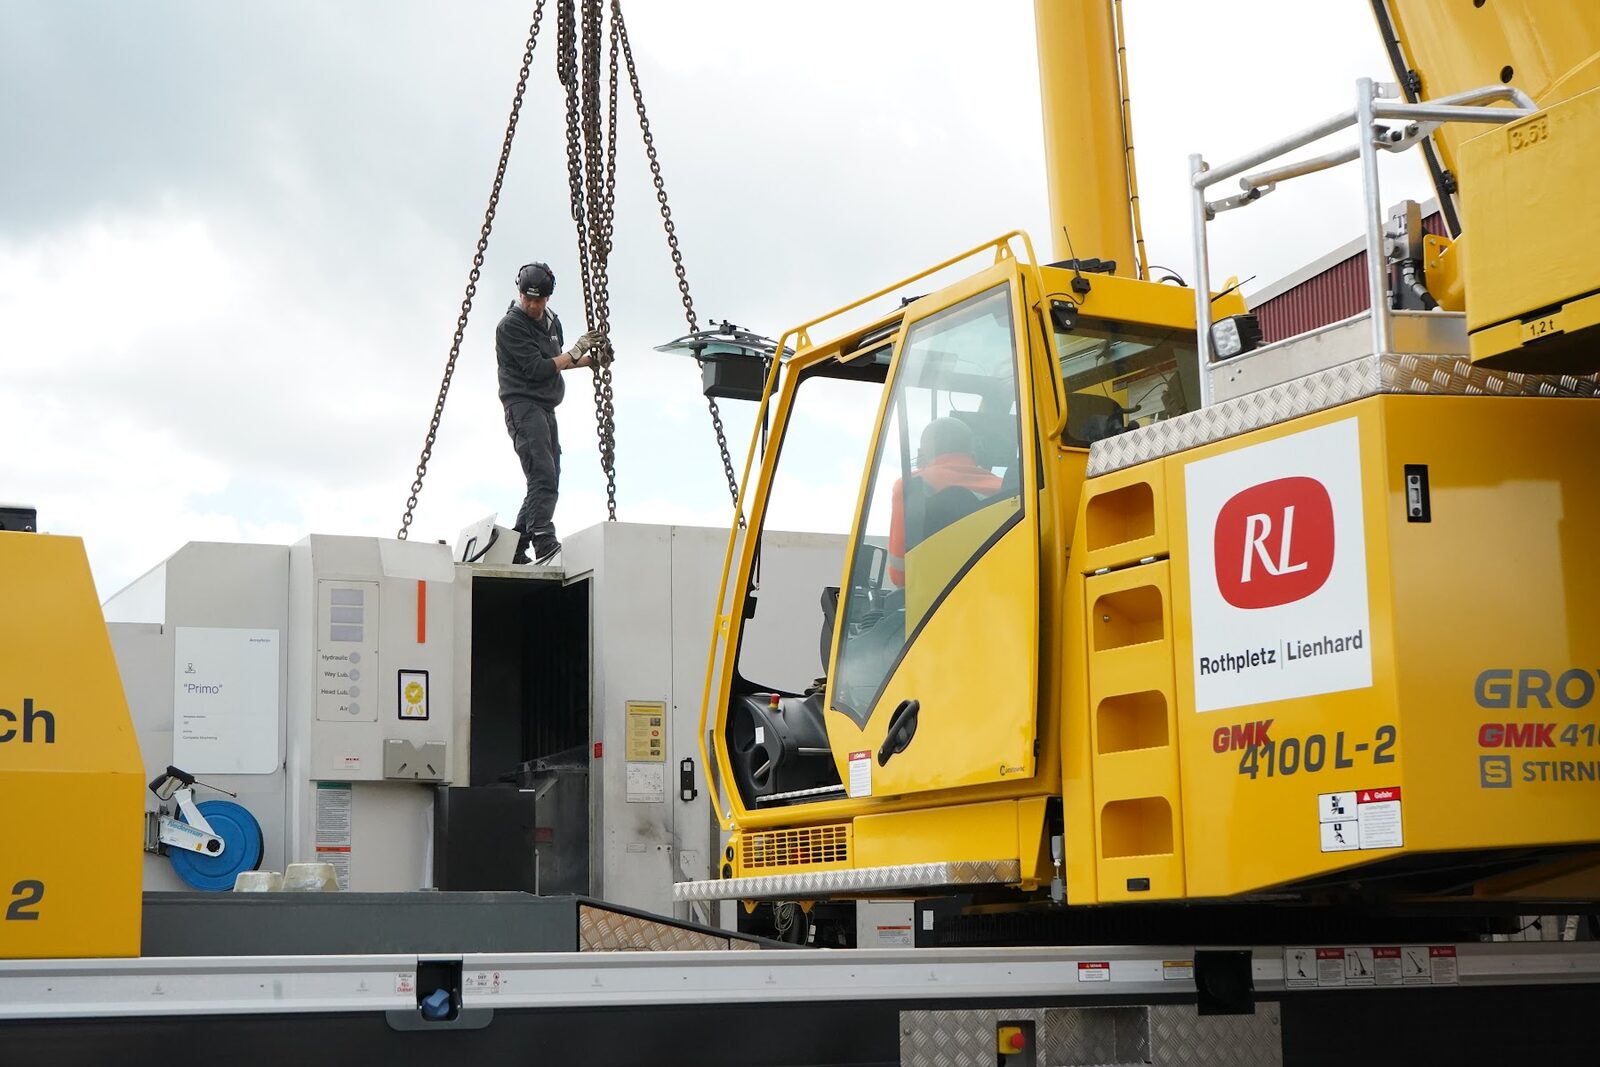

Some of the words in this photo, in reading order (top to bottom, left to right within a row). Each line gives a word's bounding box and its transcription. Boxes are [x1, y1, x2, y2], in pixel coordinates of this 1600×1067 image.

[1240, 505, 1308, 583] RL
[321, 653, 349, 661] Hydraulic
[1200, 648, 1276, 675] Rothpletz
[1287, 630, 1363, 661] Lienhard
[1474, 669, 1600, 709] GRO
[1213, 719, 1275, 754] GMK
[1478, 723, 1557, 748] GMK
[1560, 723, 1600, 748] 41
[168, 820, 204, 838] Nederman
[5, 879, 45, 920] 2
